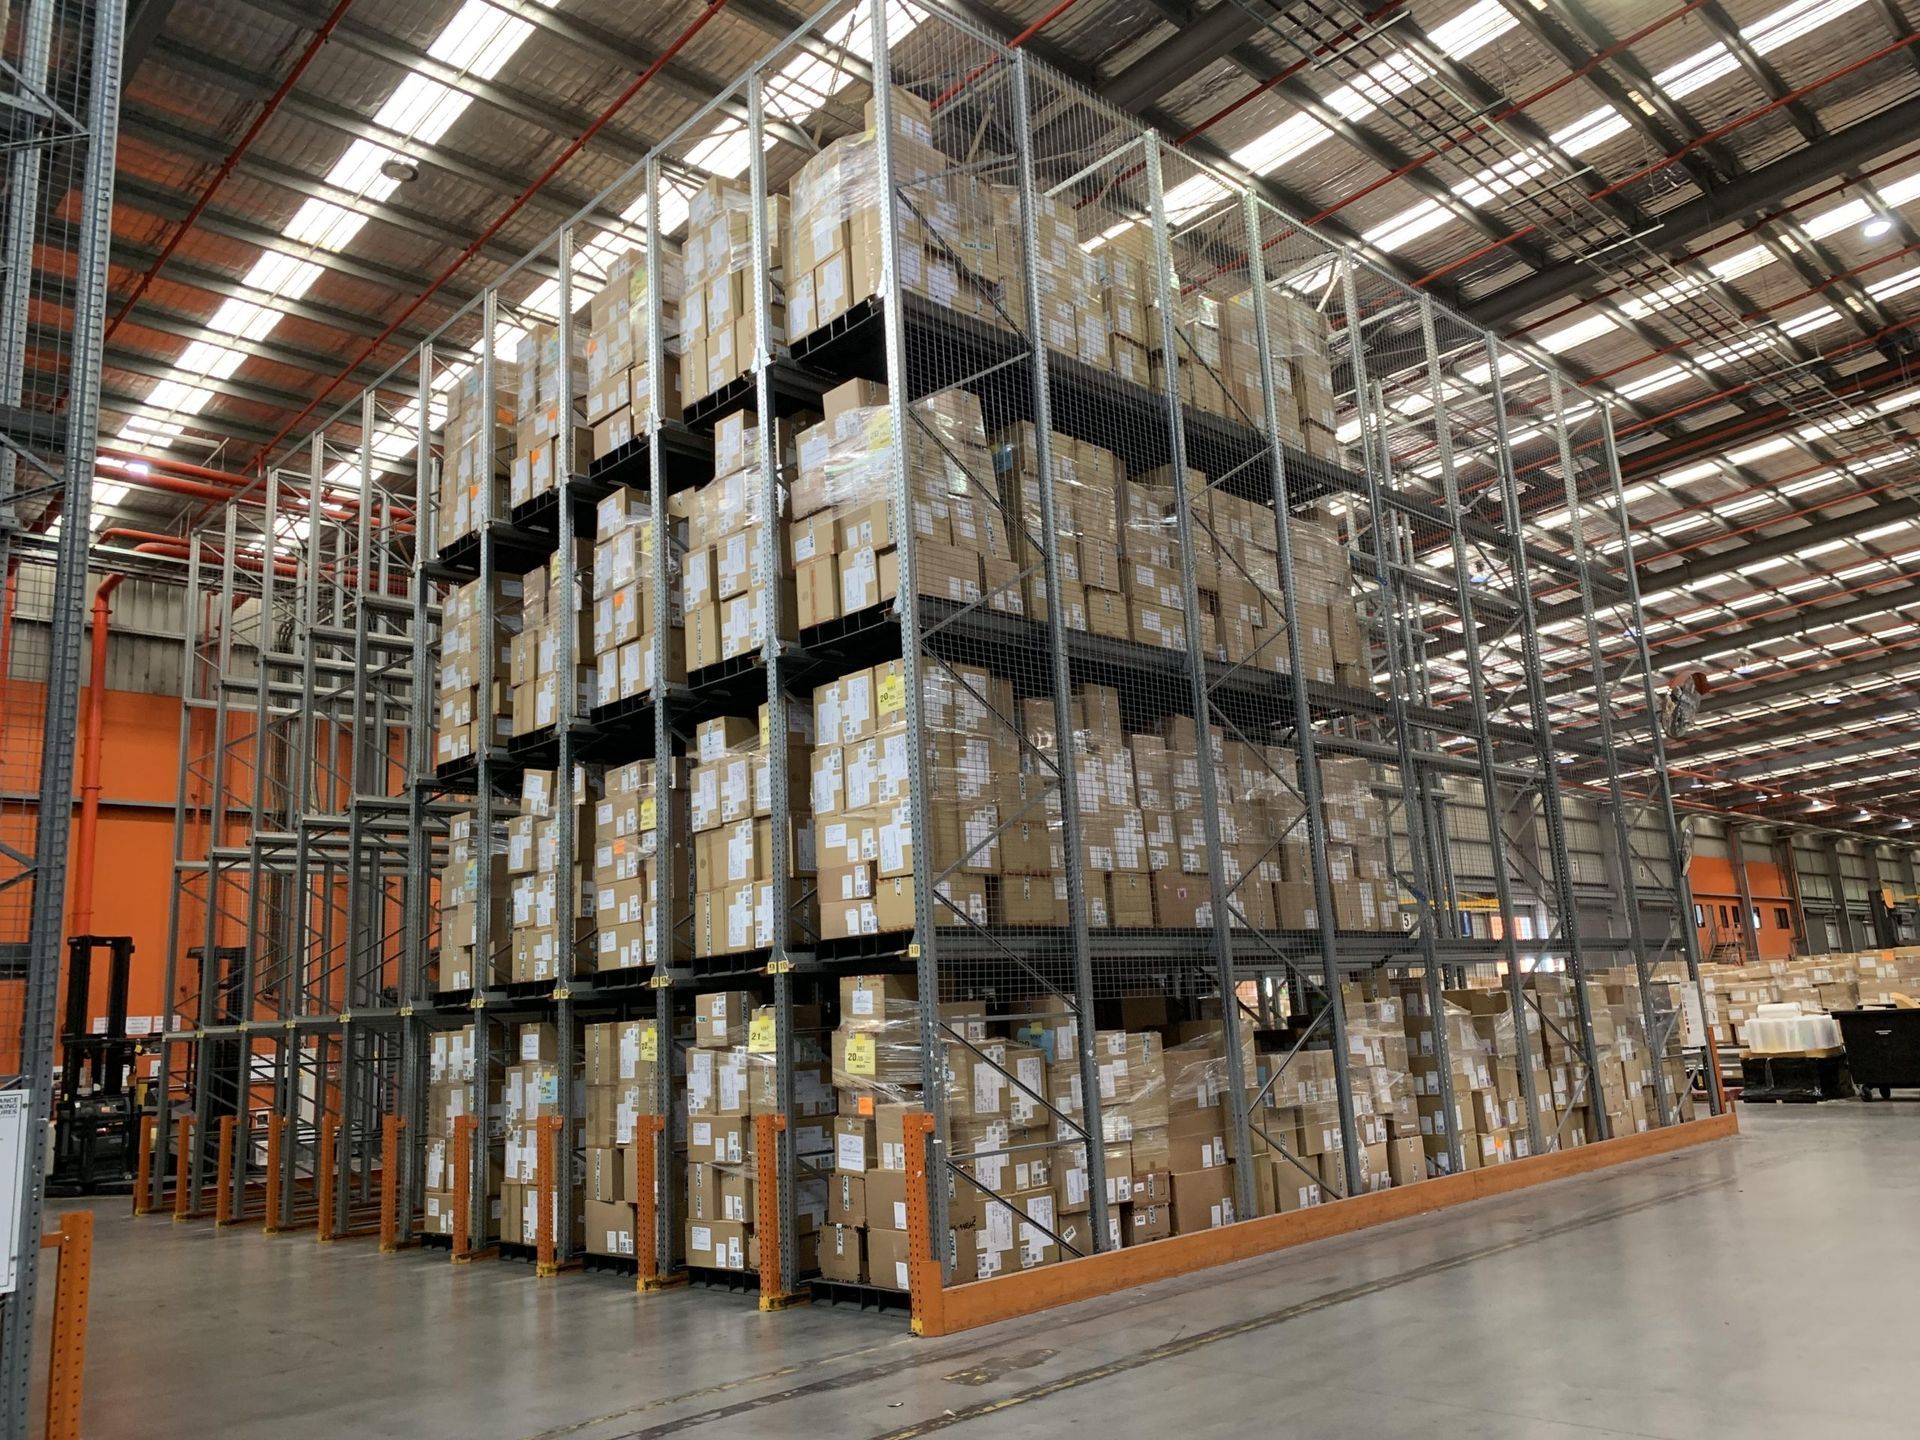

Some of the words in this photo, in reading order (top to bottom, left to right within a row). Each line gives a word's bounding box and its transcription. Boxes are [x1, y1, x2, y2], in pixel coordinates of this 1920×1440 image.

[1403, 914, 1409, 927] 5
[911, 946, 919, 954] 10
[779, 962, 787, 970] 10
[751, 1032, 760, 1041] 21
[848, 1053, 856, 1062] 20
